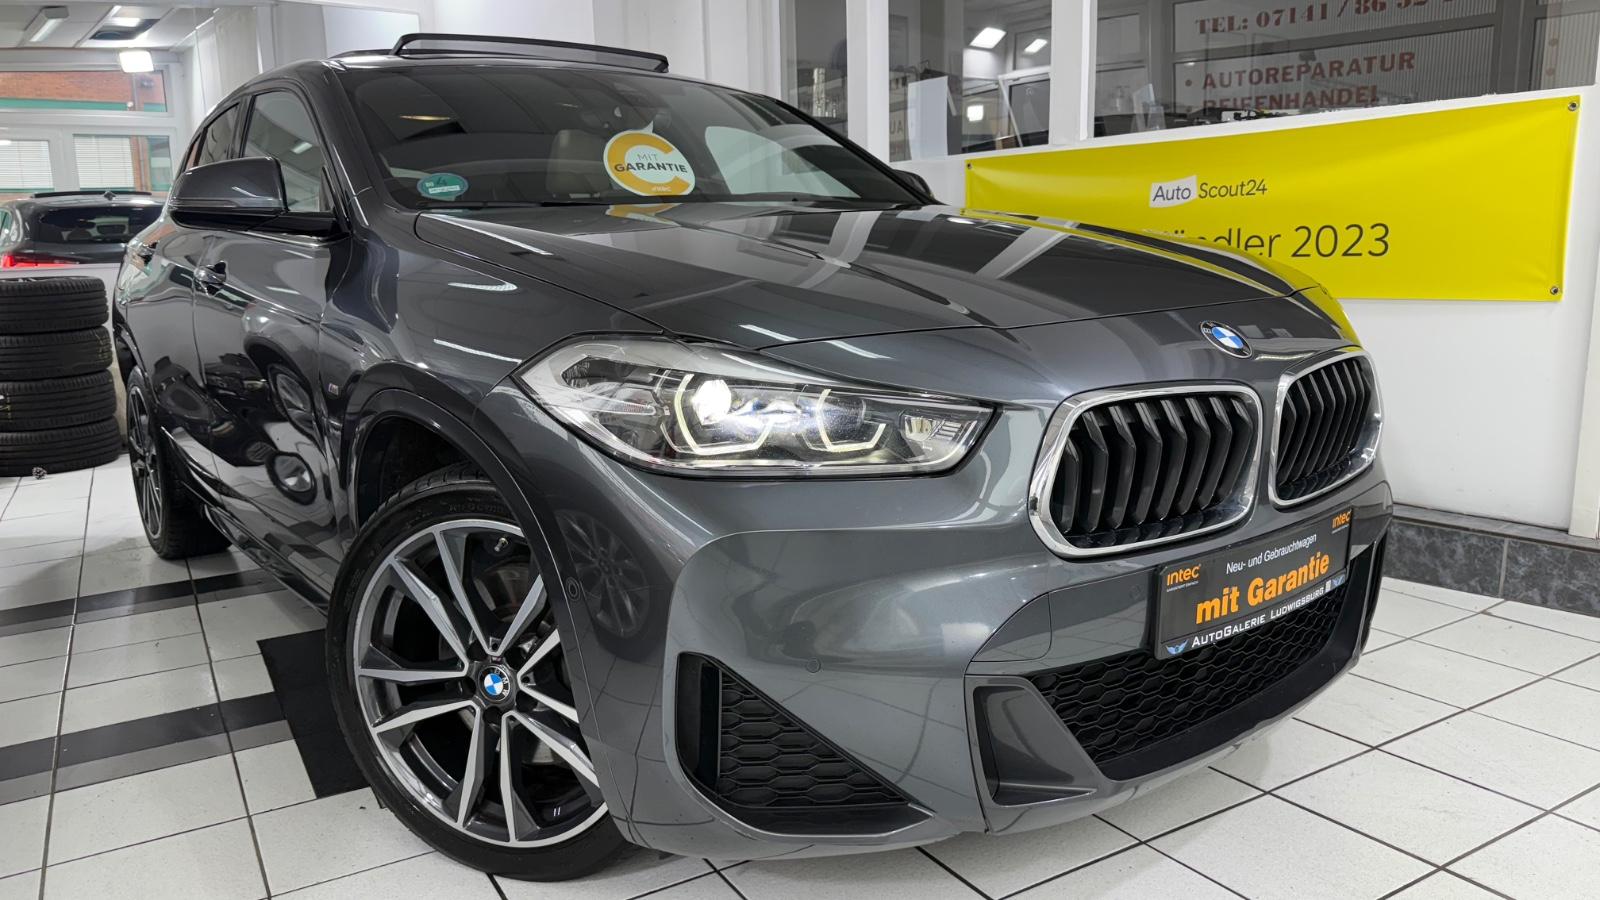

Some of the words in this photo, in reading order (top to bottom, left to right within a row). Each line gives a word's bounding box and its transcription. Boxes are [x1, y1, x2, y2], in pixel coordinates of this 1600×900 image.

[1196, 16, 1249, 34] TEL:
[1256, 4, 1328, 28] 07141
[1203, 52, 1415, 89] AUTOREPARATUR
[614, 162, 688, 173] GARANTIE
[637, 153, 657, 161] MIT
[1152, 184, 1192, 202] Auto
[1198, 179, 1268, 199] Scout24
[1291, 222, 1390, 258] 2023
[1226, 560, 1246, 575] Neu-
[1248, 552, 1263, 568] und
[1264, 533, 1317, 562] Gebrauchtwagen
[1196, 586, 1240, 624] mit
[1247, 551, 1330, 607] Garantie
